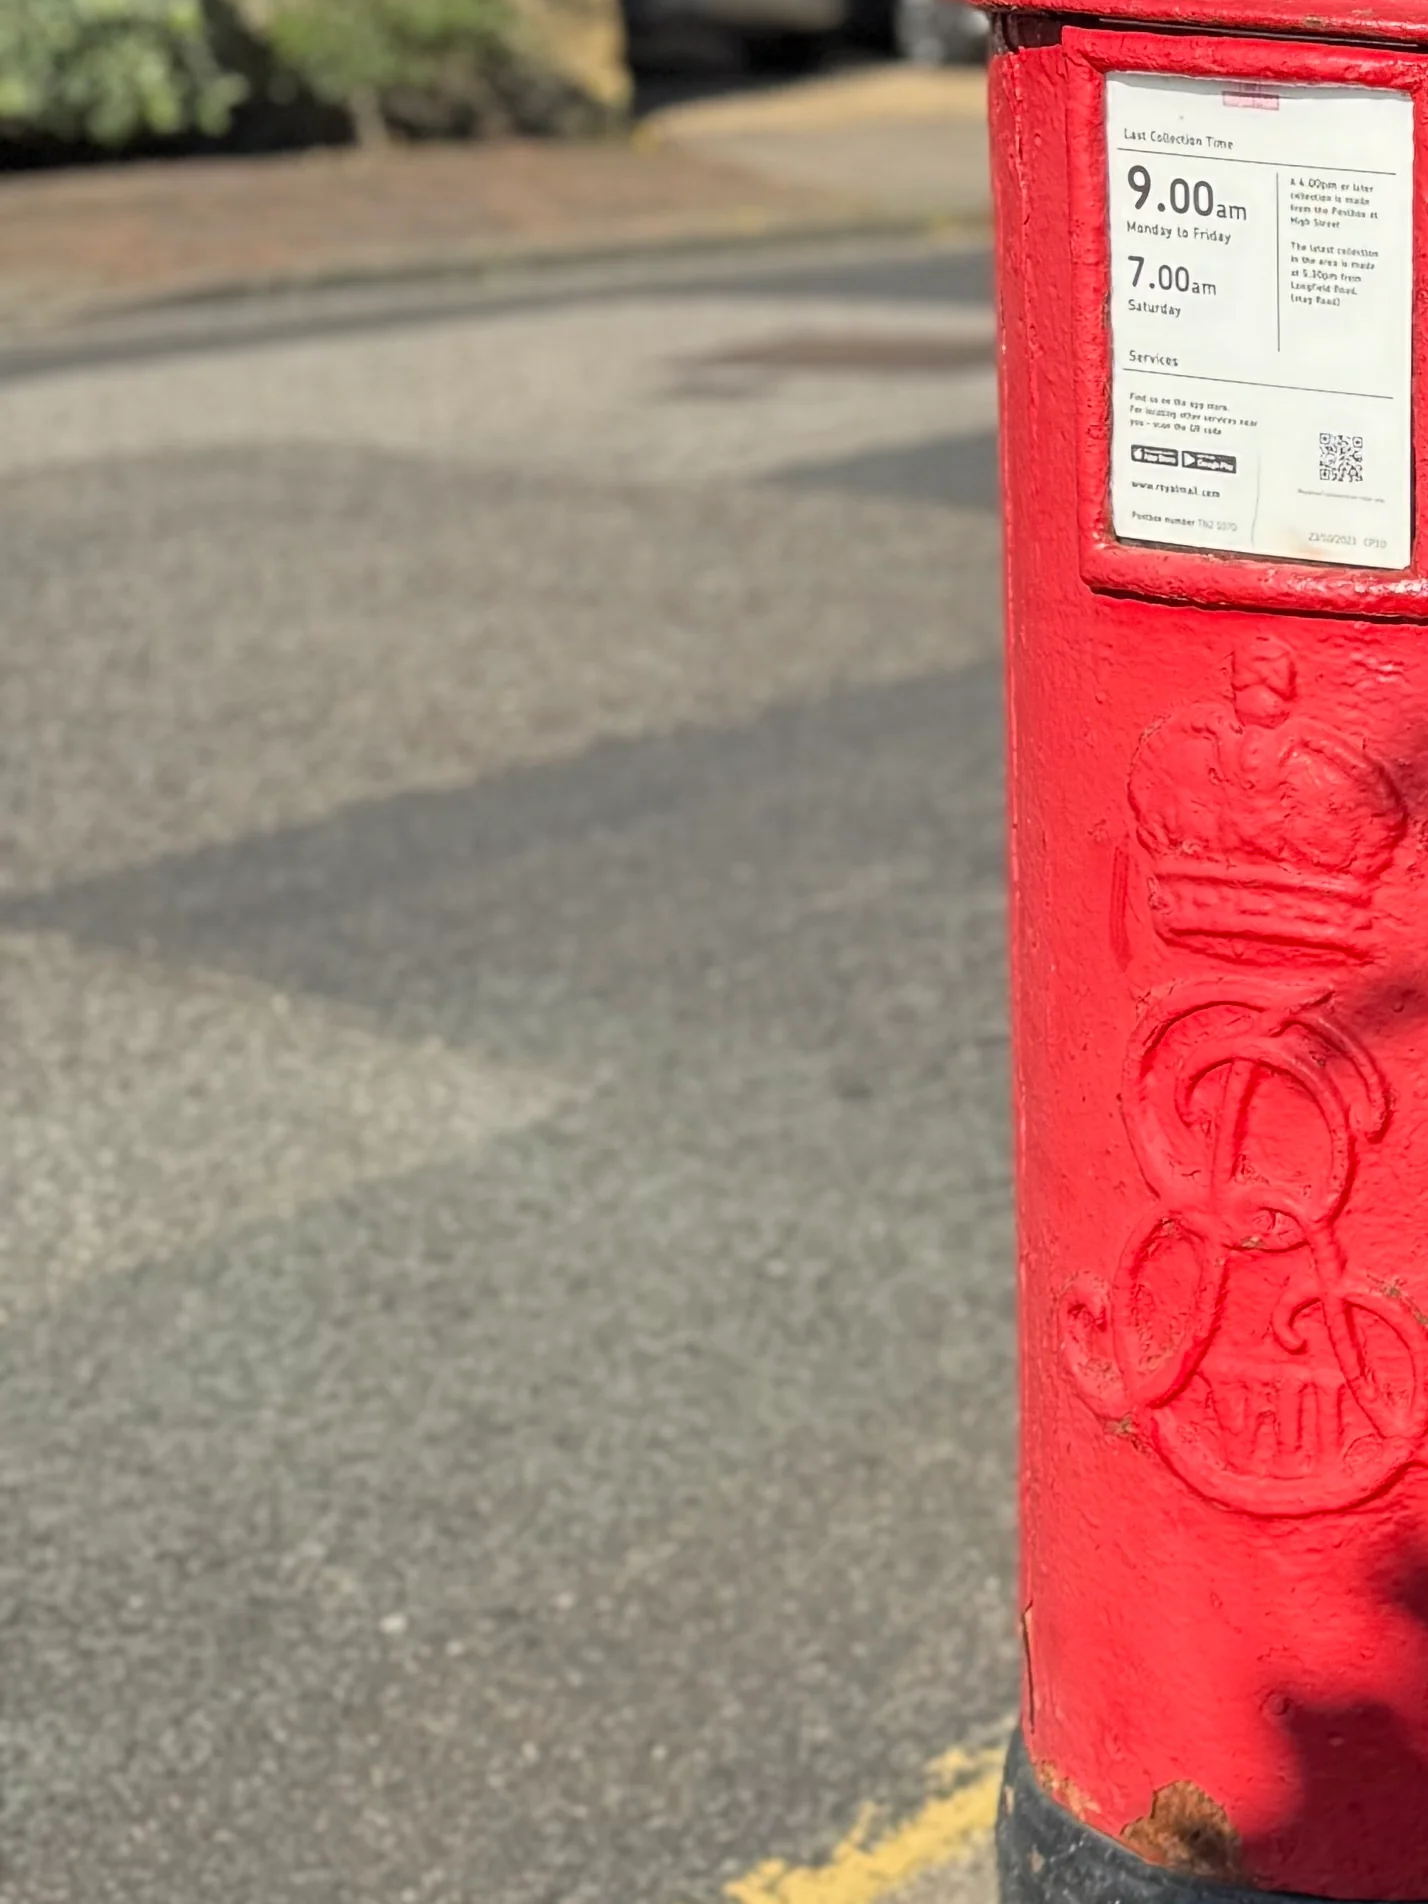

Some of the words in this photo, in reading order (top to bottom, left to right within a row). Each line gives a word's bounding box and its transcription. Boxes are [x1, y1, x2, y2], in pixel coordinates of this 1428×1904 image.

[1124, 128, 1146, 141] Last
[1150, 130, 1202, 146] Collection
[1206, 136, 1234, 150] Time
[1127, 164, 1247, 221] 9.00am
[1126, 220, 1172, 240] Monday
[1177, 227, 1189, 238] to
[1193, 227, 1232, 245] Friday
[1127, 255, 1217, 296] 7.00am
[1128, 299, 1181, 318] Saturday
[1129, 350, 1179, 367] Services
